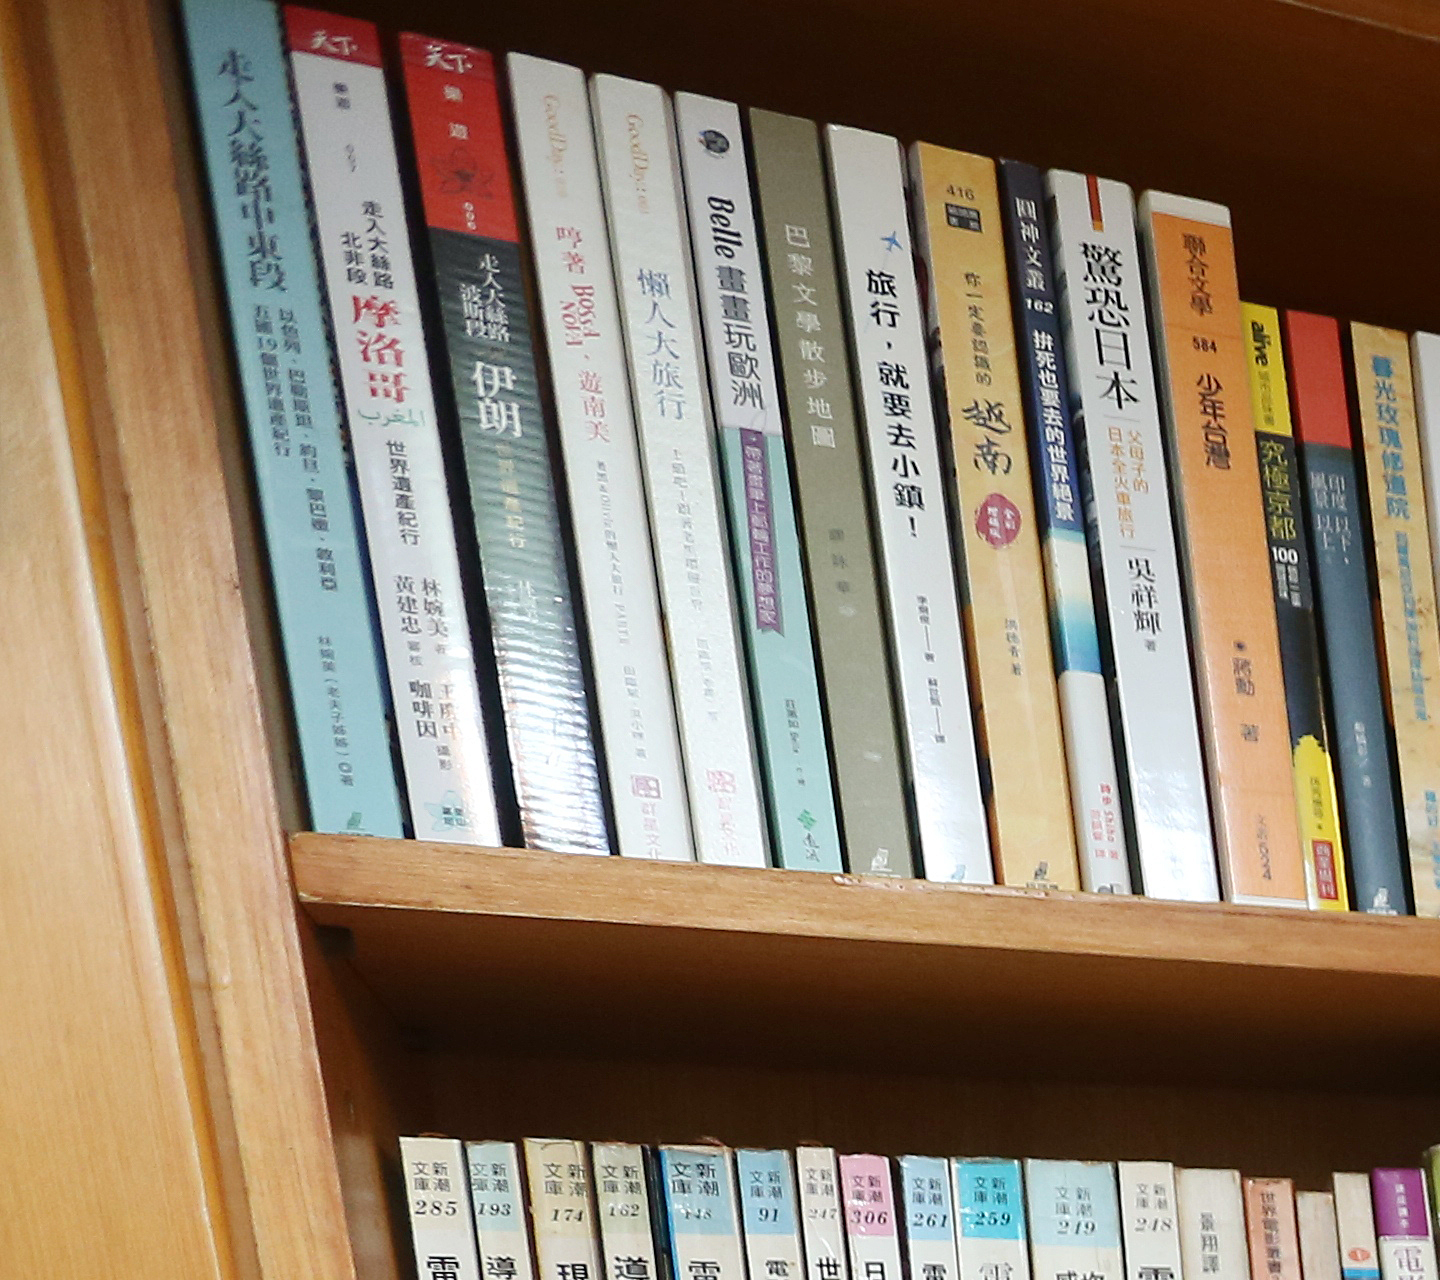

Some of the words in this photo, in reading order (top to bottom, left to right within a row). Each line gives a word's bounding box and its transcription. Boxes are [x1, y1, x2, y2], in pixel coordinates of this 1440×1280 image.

[351, 294, 407, 404] 摩洛哥
[636, 267, 687, 421] 懶人大旅行
[784, 224, 838, 448] 巴黎文學散步地圖
[1024, 297, 1055, 316] 162
[1079, 240, 1141, 411] 驚恐日本
[1191, 335, 1218, 355] 584
[471, 360, 524, 438] 伊朗
[961, 398, 1013, 477] 越南
[1195, 371, 1232, 472] 少年台灣
[385, 440, 421, 547] 世界遺產紀行
[1258, 439, 1299, 543] 究極京都
[1270, 546, 1299, 565] 100
[414, 1200, 458, 1217] 285
